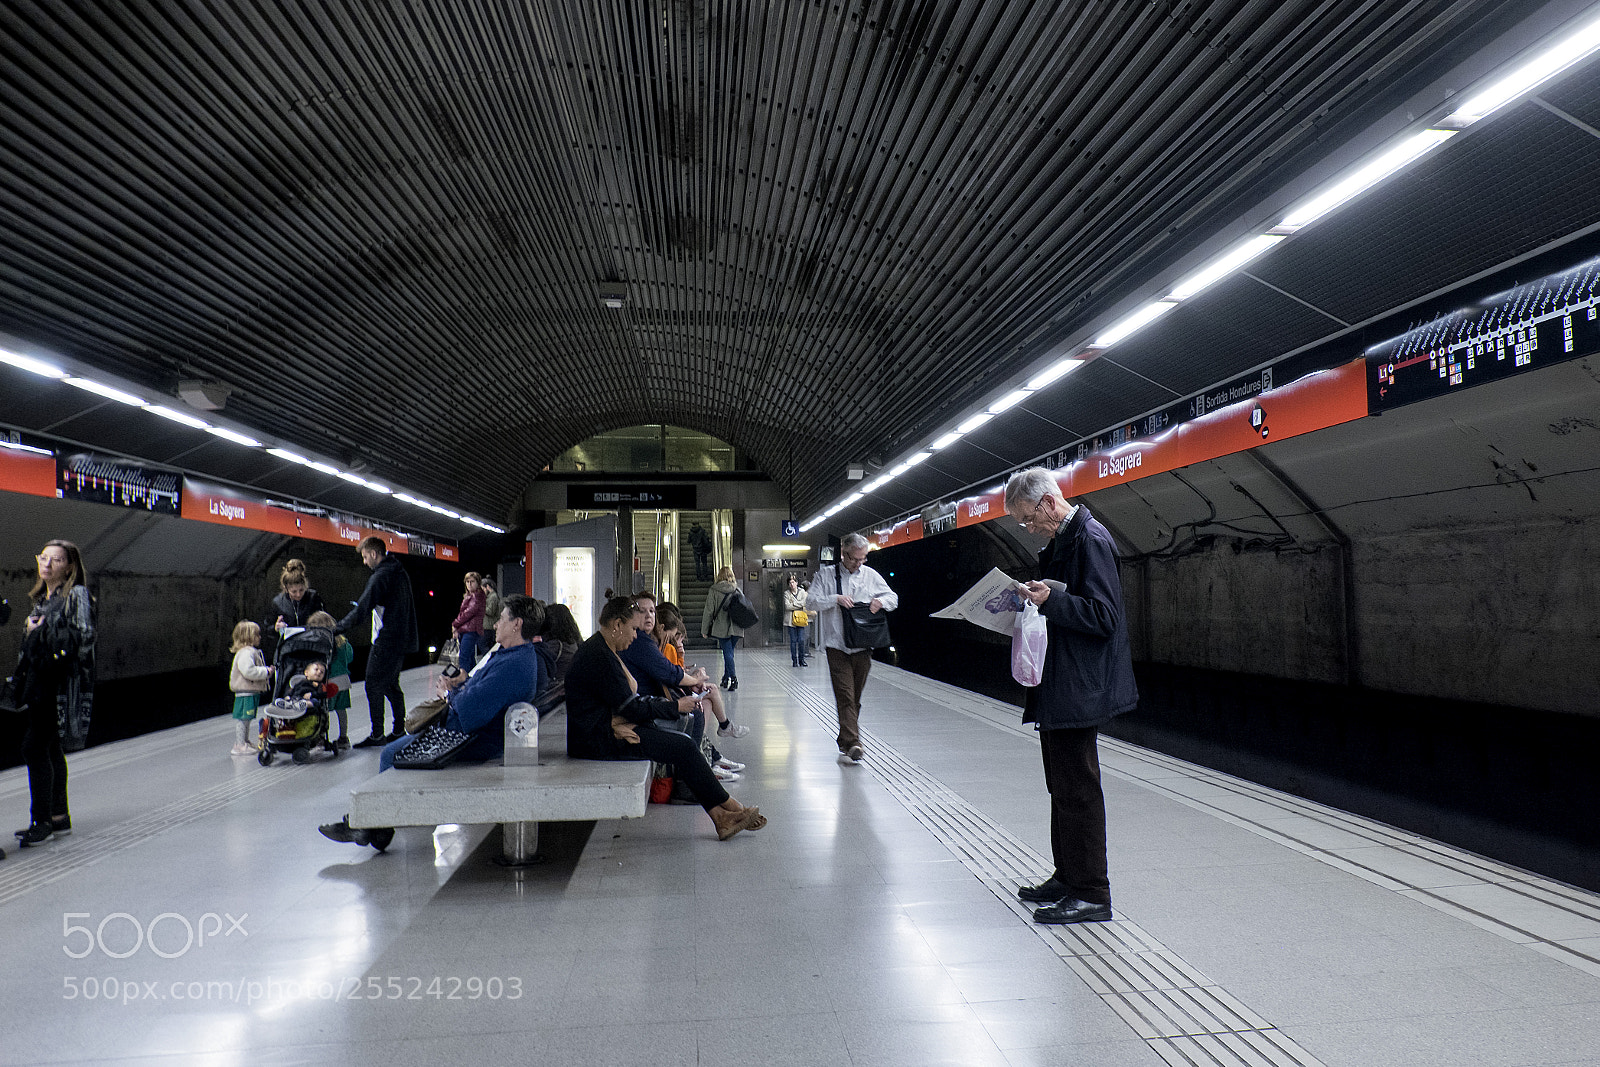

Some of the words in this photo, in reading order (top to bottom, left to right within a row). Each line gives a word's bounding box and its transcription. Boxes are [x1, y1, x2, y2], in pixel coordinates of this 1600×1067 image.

[1552, 276, 1568, 305] Rocafort
[1563, 271, 1581, 301] Espanya
[1518, 285, 1535, 317] Catalunya
[1540, 288, 1553, 309] Urgell
[1467, 321, 1475, 335] Clot
[1486, 307, 1498, 328] Marina
[1457, 319, 1467, 338] Navas
[1380, 368, 1387, 379] L1
[1206, 391, 1228, 408] Sortida
[1229, 380, 1261, 400] Hondures
[1098, 460, 1108, 478] La
[1109, 451, 1142, 476] Sagrera
[209, 498, 219, 515] La
[219, 500, 245, 520] Sagrera
[968, 504, 974, 517] La
[974, 502, 989, 517] Sagrera
[340, 526, 346, 539] La
